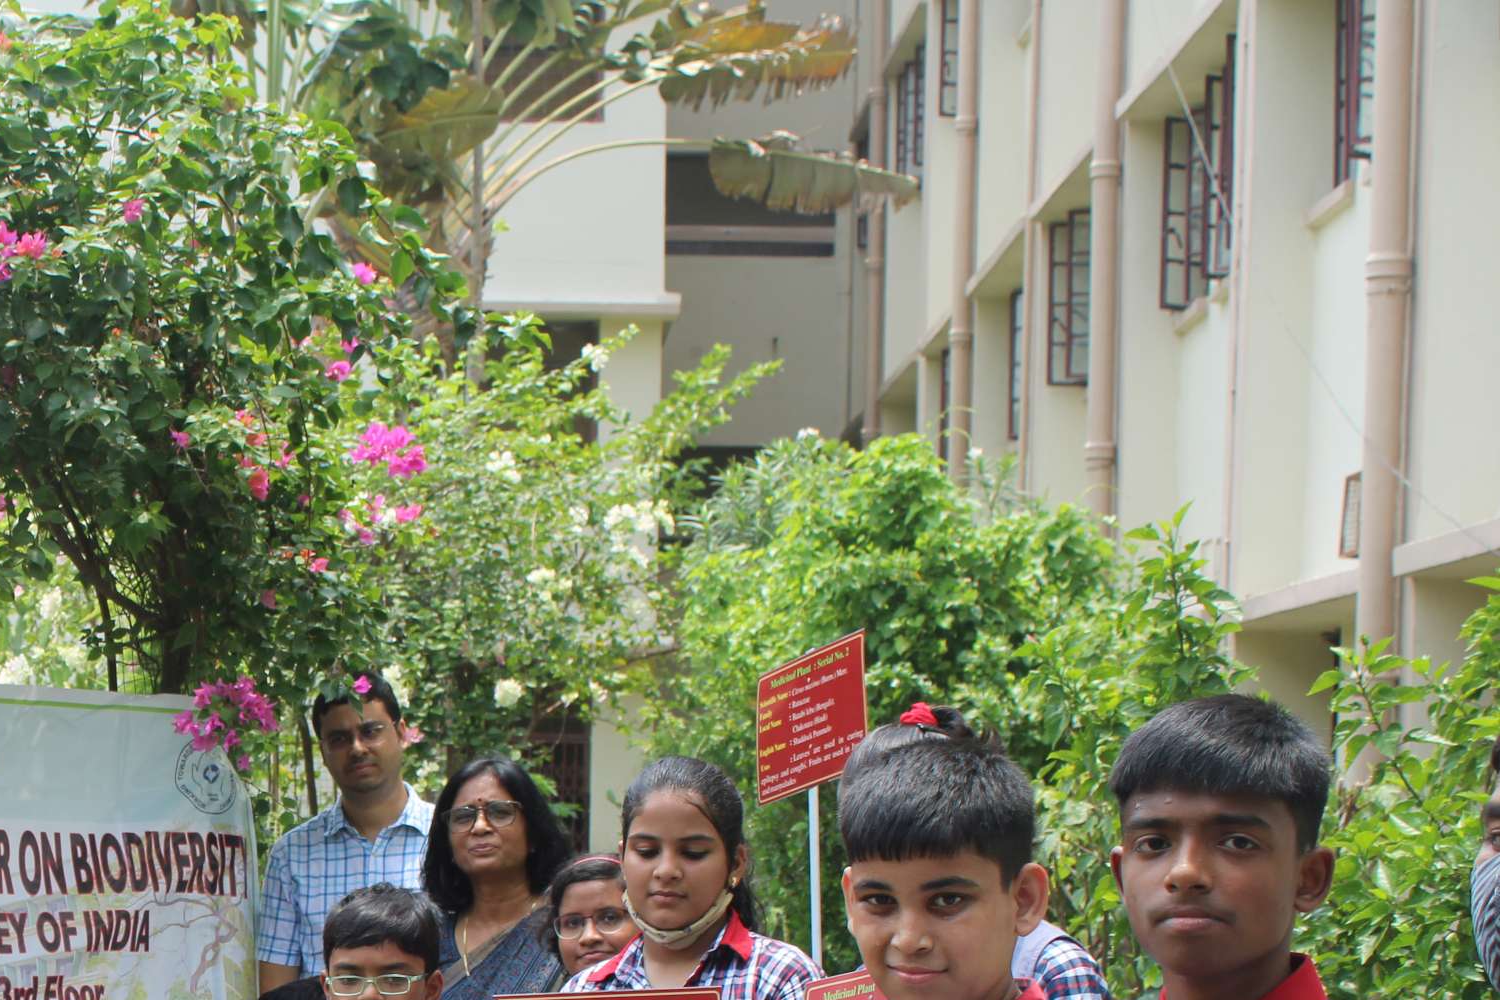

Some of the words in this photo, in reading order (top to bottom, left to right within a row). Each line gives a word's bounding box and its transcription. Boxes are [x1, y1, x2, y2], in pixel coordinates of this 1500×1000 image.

[18, 830, 68, 896] ON
[36, 911, 78, 954] OF
[84, 910, 150, 952] INDIA
